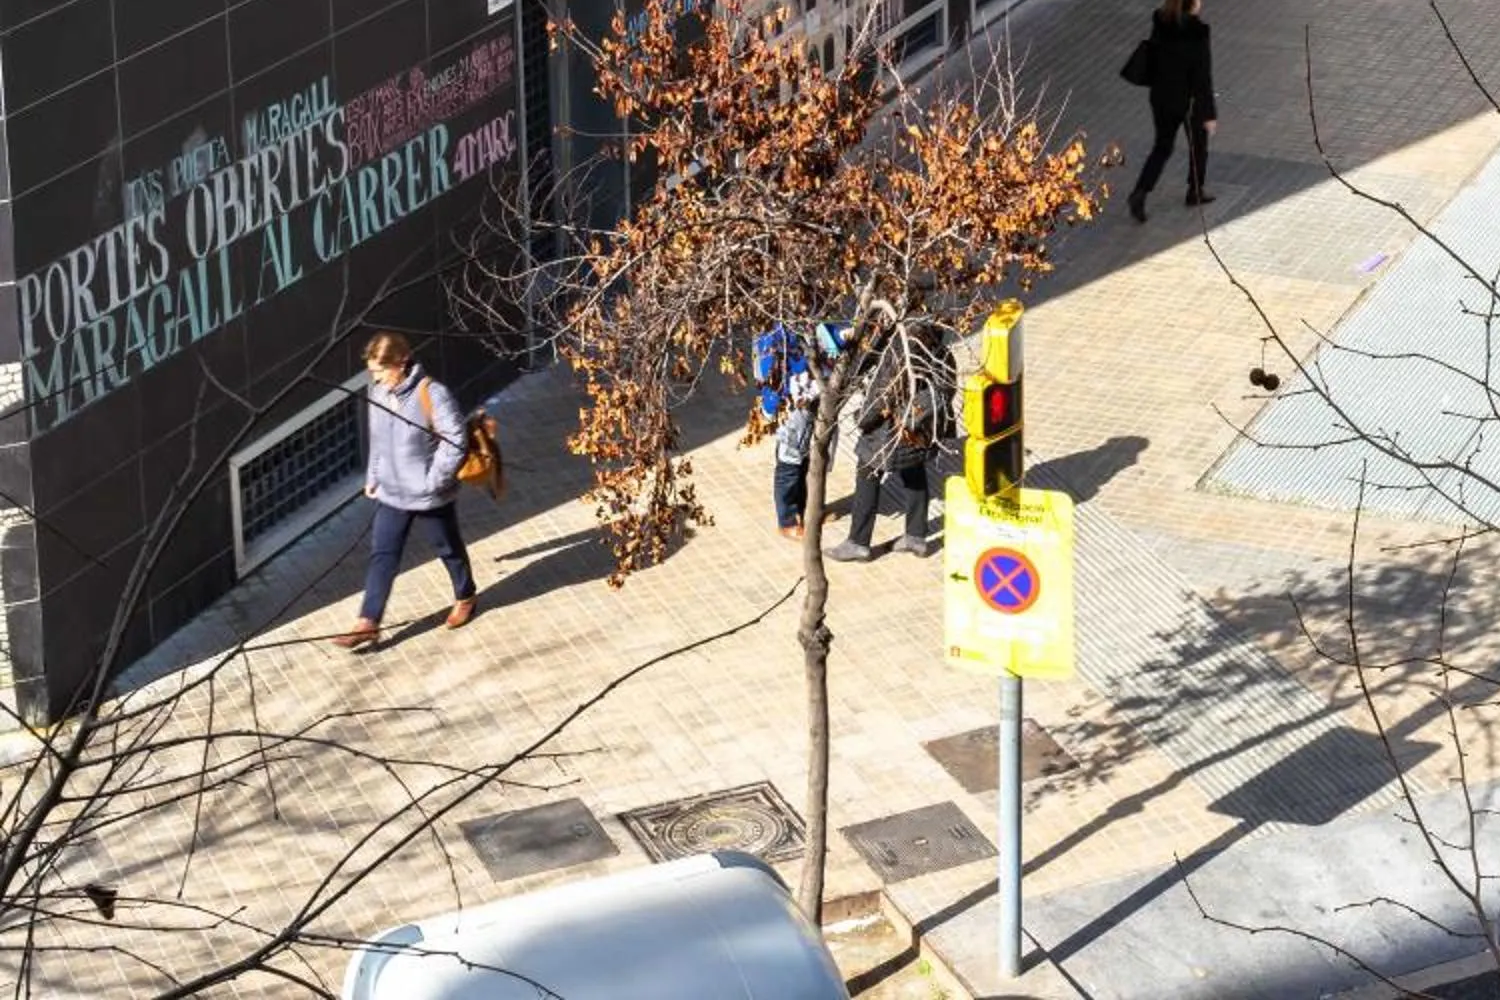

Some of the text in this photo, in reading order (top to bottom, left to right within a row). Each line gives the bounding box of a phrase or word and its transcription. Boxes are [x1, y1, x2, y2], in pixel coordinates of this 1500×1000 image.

[18, 106, 349, 359] PORTES OBERTES
[170, 136, 231, 197] POETA
[244, 75, 338, 152] MARAGALL
[22, 245, 245, 438] MARAGALL
[258, 215, 303, 303] AL
[313, 122, 452, 263] CARRER
